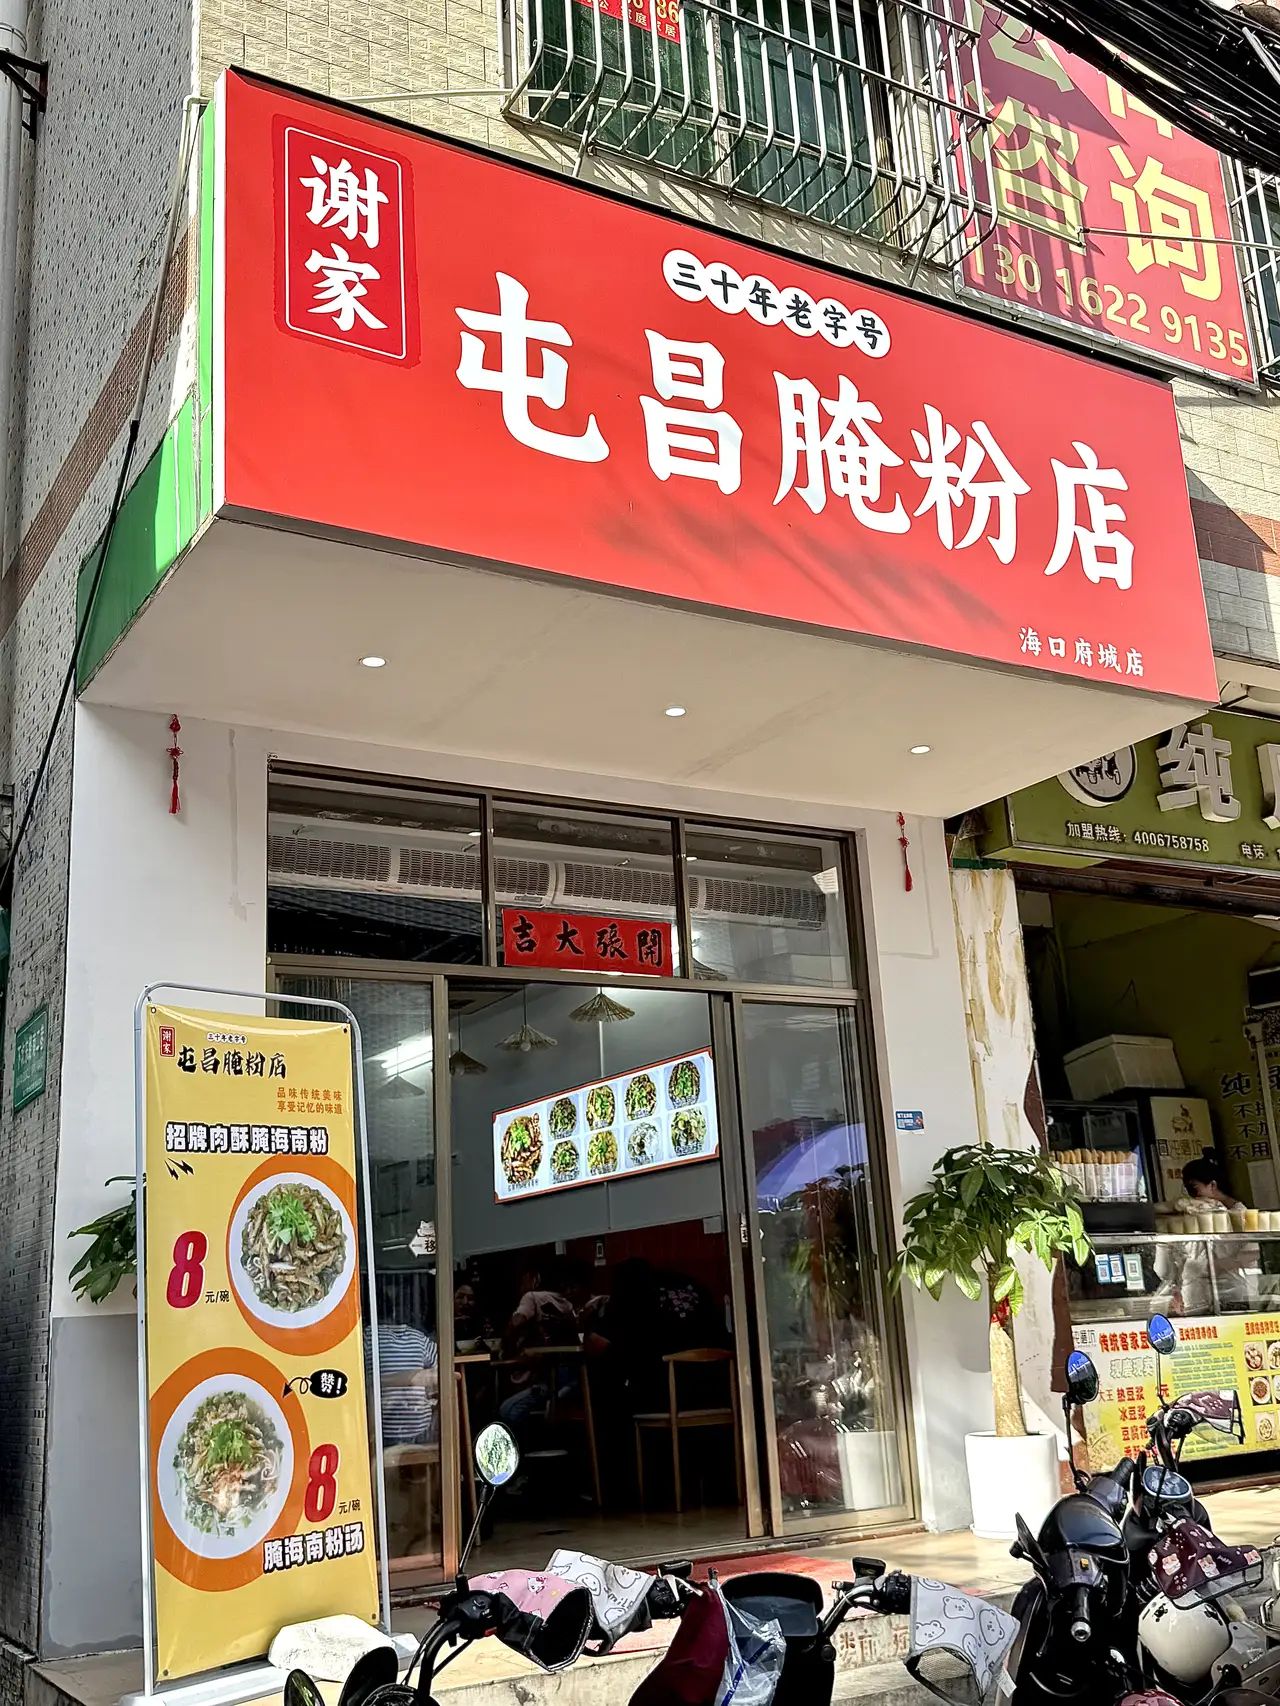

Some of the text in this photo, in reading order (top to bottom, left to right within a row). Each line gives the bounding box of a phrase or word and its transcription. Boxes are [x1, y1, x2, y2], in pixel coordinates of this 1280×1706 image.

[963, 79, 1222, 301] 咨询
[299, 153, 389, 331] 谢家
[671, 260, 885, 351] 三十年老字号
[966, 236, 1248, 367] 130 1622 9135
[455, 271, 1136, 591] 屯昌腌粉店
[1018, 627, 1144, 677] 海口府城店
[177, 1044, 287, 1079] 屯昌腌粉店
[207, 1033, 247, 1044] 三十年老字号
[277, 1087, 342, 1101] 品味传统美味
[277, 1101, 343, 1115] 享受记忆的味道
[165, 1122, 328, 1154] 招牌肉酥腌海南粉
[166, 1231, 230, 1309] 8 元/碗
[304, 1443, 361, 1523] 8 元/碗
[263, 1523, 364, 1573] 腌海南粉汤
